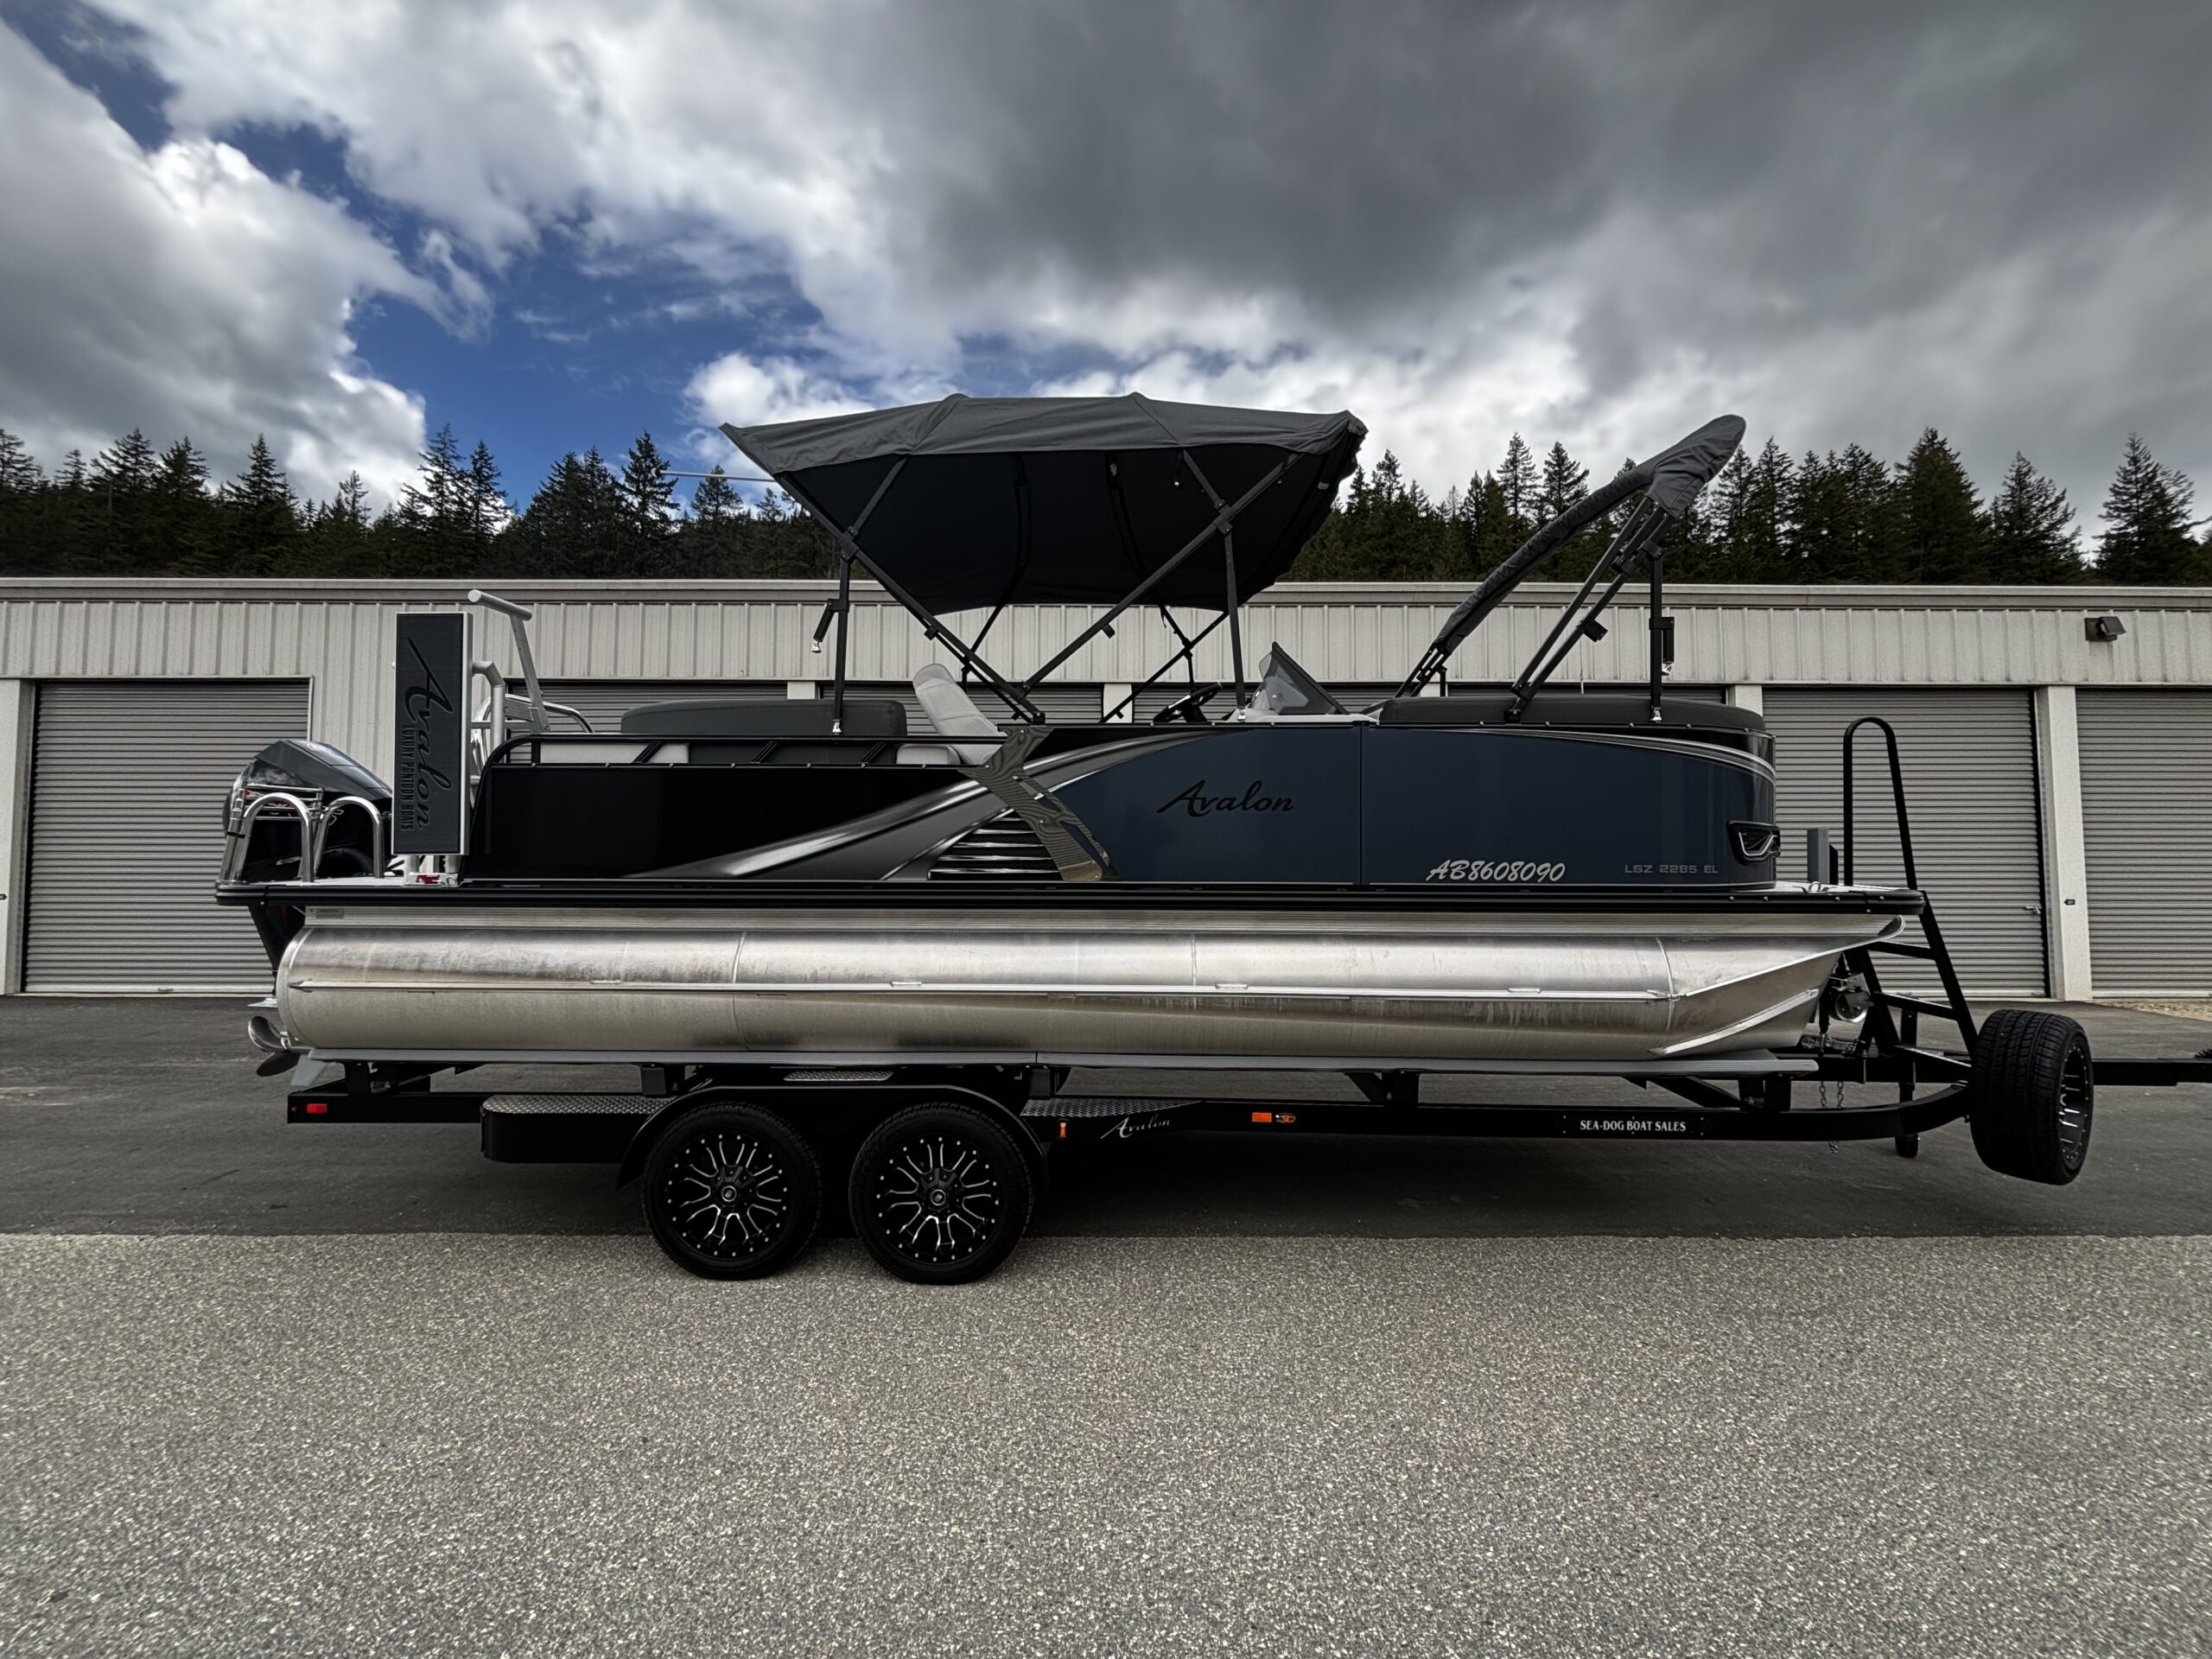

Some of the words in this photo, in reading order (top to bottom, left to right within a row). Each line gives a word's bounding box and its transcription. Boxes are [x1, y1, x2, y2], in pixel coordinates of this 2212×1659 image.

[401, 724, 416, 760] LUXURY
[404, 635, 454, 830] Avalon
[400, 762, 415, 801] PONTOON
[1155, 779, 1295, 817] Avalon
[400, 804, 415, 830] BOATS
[1425, 859, 1567, 883] AB8608090
[1624, 864, 1654, 874] LSZ
[1659, 864, 1698, 874] 2285
[1703, 864, 1719, 874] EL
[1098, 1112, 1171, 1140] Avalon
[1580, 1119, 1624, 1131] SEA-DOG
[1626, 1120, 1653, 1132] BOAT
[1655, 1121, 1687, 1133] SALES
